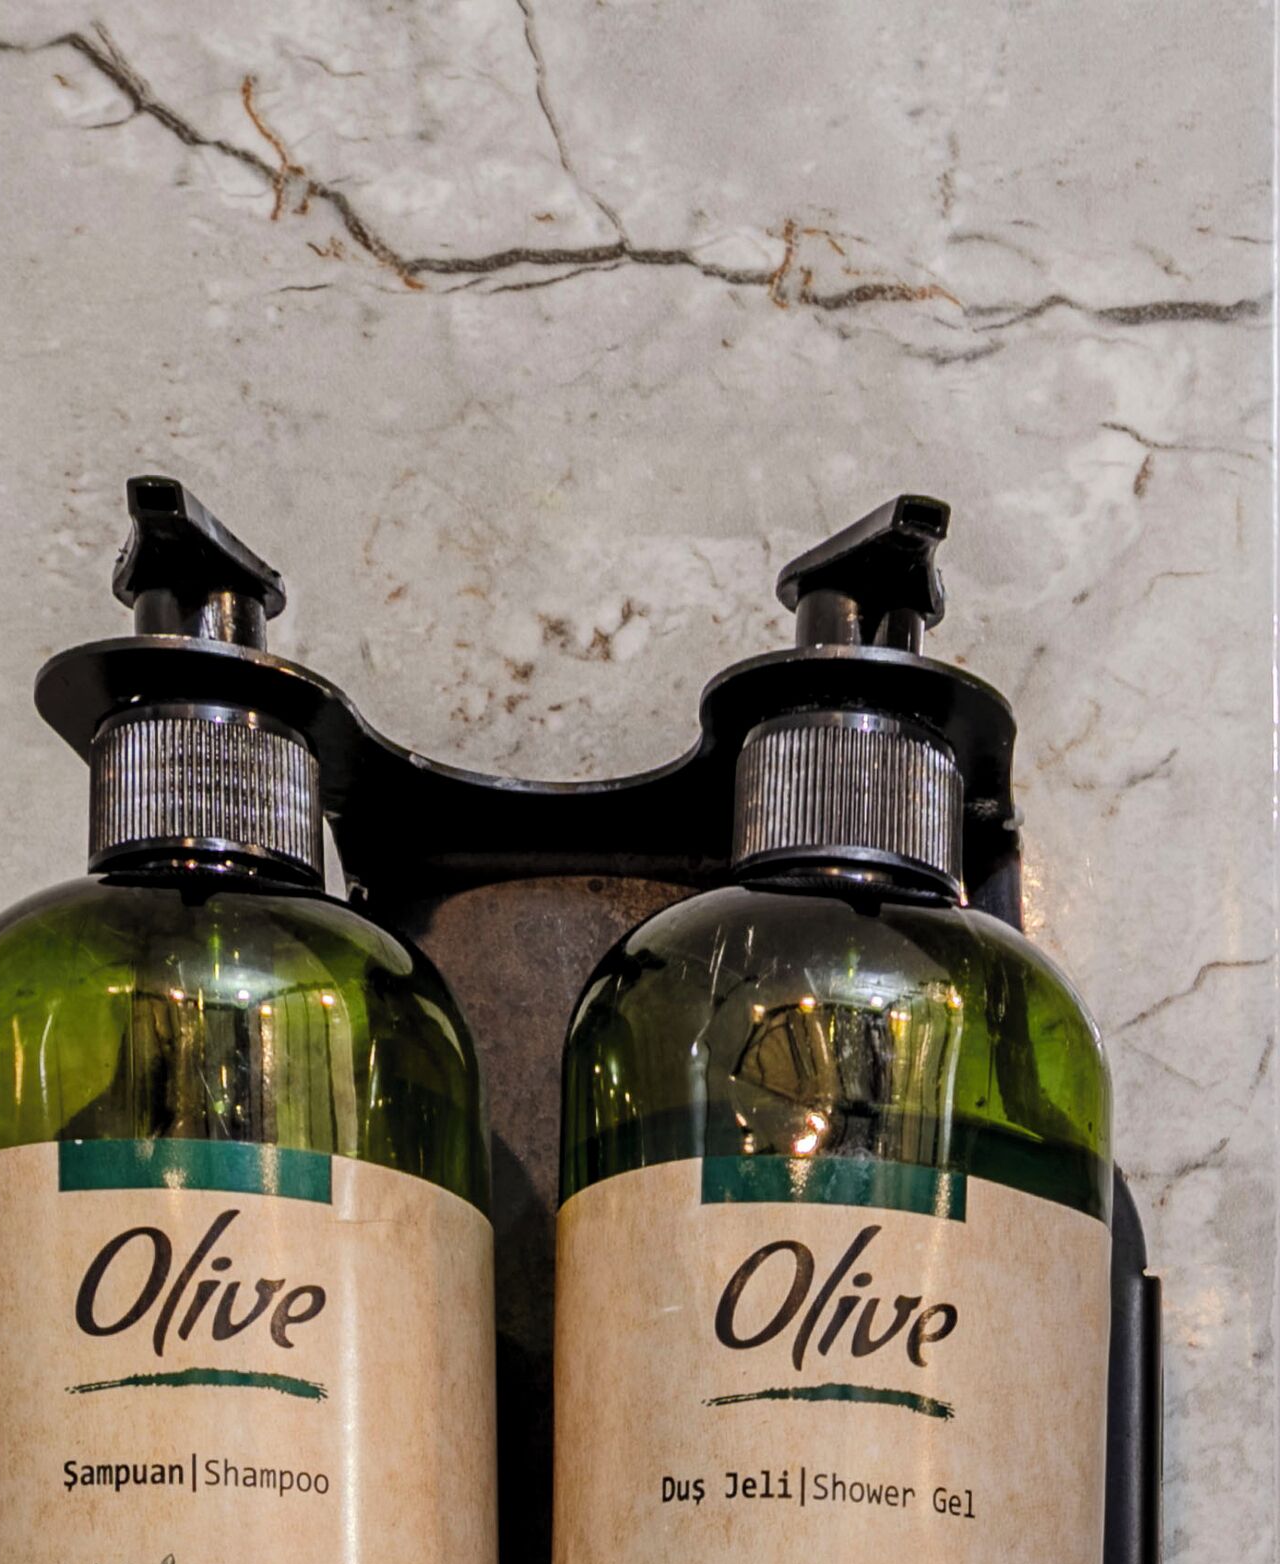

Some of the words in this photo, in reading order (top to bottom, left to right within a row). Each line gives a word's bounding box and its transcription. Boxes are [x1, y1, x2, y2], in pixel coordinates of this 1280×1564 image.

[74, 1208, 328, 1358] Olive
[714, 1224, 960, 1372] Olive
[661, 1475, 706, 1507] Duş
[932, 1486, 977, 1520] Gel
